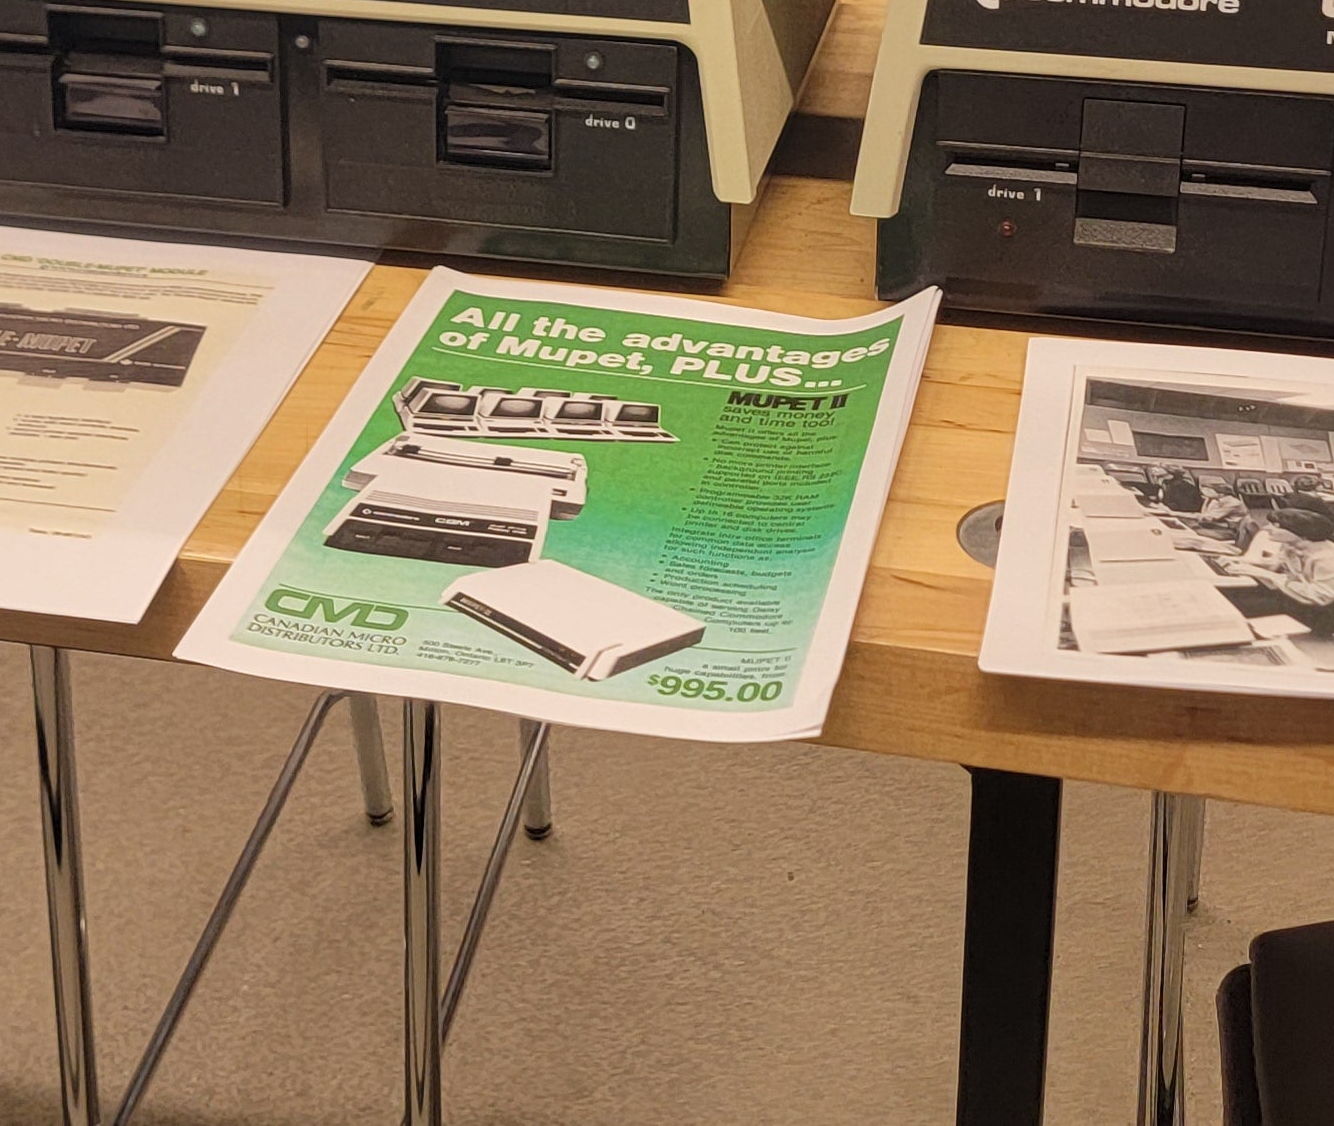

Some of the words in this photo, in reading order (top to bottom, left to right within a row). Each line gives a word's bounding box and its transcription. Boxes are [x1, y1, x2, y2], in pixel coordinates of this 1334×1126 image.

[190, 78, 224, 95] drive
[230, 81, 240, 96] 1
[584, 113, 620, 129] drive
[988, 184, 1025, 200] drive
[1034, 187, 1043, 202] 1
[450, 306, 521, 333] All
[532, 317, 606, 343] the
[621, 332, 892, 369] advantages
[438, 331, 487, 350] of
[495, 335, 654, 375] Mupet,
[670, 355, 843, 389] PLUS...
[727, 390, 828, 411] MUPET
[722, 405, 770, 417] saves
[776, 410, 836, 420] money
[719, 414, 753, 425] and
[759, 417, 797, 428] time
[716, 464, 774, 475] background
[695, 495, 743, 505] controller
[699, 488, 770, 500] Programmable
[796, 493, 820, 501] RAM
[690, 507, 705, 516] Up
[736, 513, 789, 522] computers
[747, 506, 794, 515] operating
[684, 519, 717, 528] printer
[721, 524, 740, 532] and
[703, 516, 755, 525] connected
[671, 526, 716, 538] Integrate
[665, 539, 708, 550] allowing
[710, 544, 773, 555] independent
[669, 532, 683, 540] for
[685, 535, 730, 545] common
[732, 540, 755, 548] data
[664, 544, 678, 552] for
[681, 547, 706, 555] such
[709, 550, 755, 561] functions
[669, 560, 696, 569] Sales
[751, 569, 793, 578] budgets
[671, 555, 730, 568] Accounting
[664, 567, 685, 575] and
[687, 571, 719, 579] orders
[663, 573, 719, 585] Production
[723, 582, 778, 592] scheduling
[645, 586, 664, 594] The
[667, 590, 690, 599] only
[692, 594, 733, 605] product
[265, 588, 409, 631] CMD
[672, 605, 716, 616] Chained
[719, 611, 784, 620] Commodore
[704, 617, 762, 627] Computers
[253, 613, 345, 638] CANADIAN
[347, 630, 408, 647] MICRO
[246, 622, 363, 651] DISTRIBUTORS
[367, 642, 400, 656] LTD.
[454, 651, 492, 661] Ontario
[741, 656, 781, 666] MUPET
[665, 665, 692, 675] huge
[712, 663, 741, 672] small
[743, 666, 771, 674] price
[647, 673, 784, 703] $995.00
